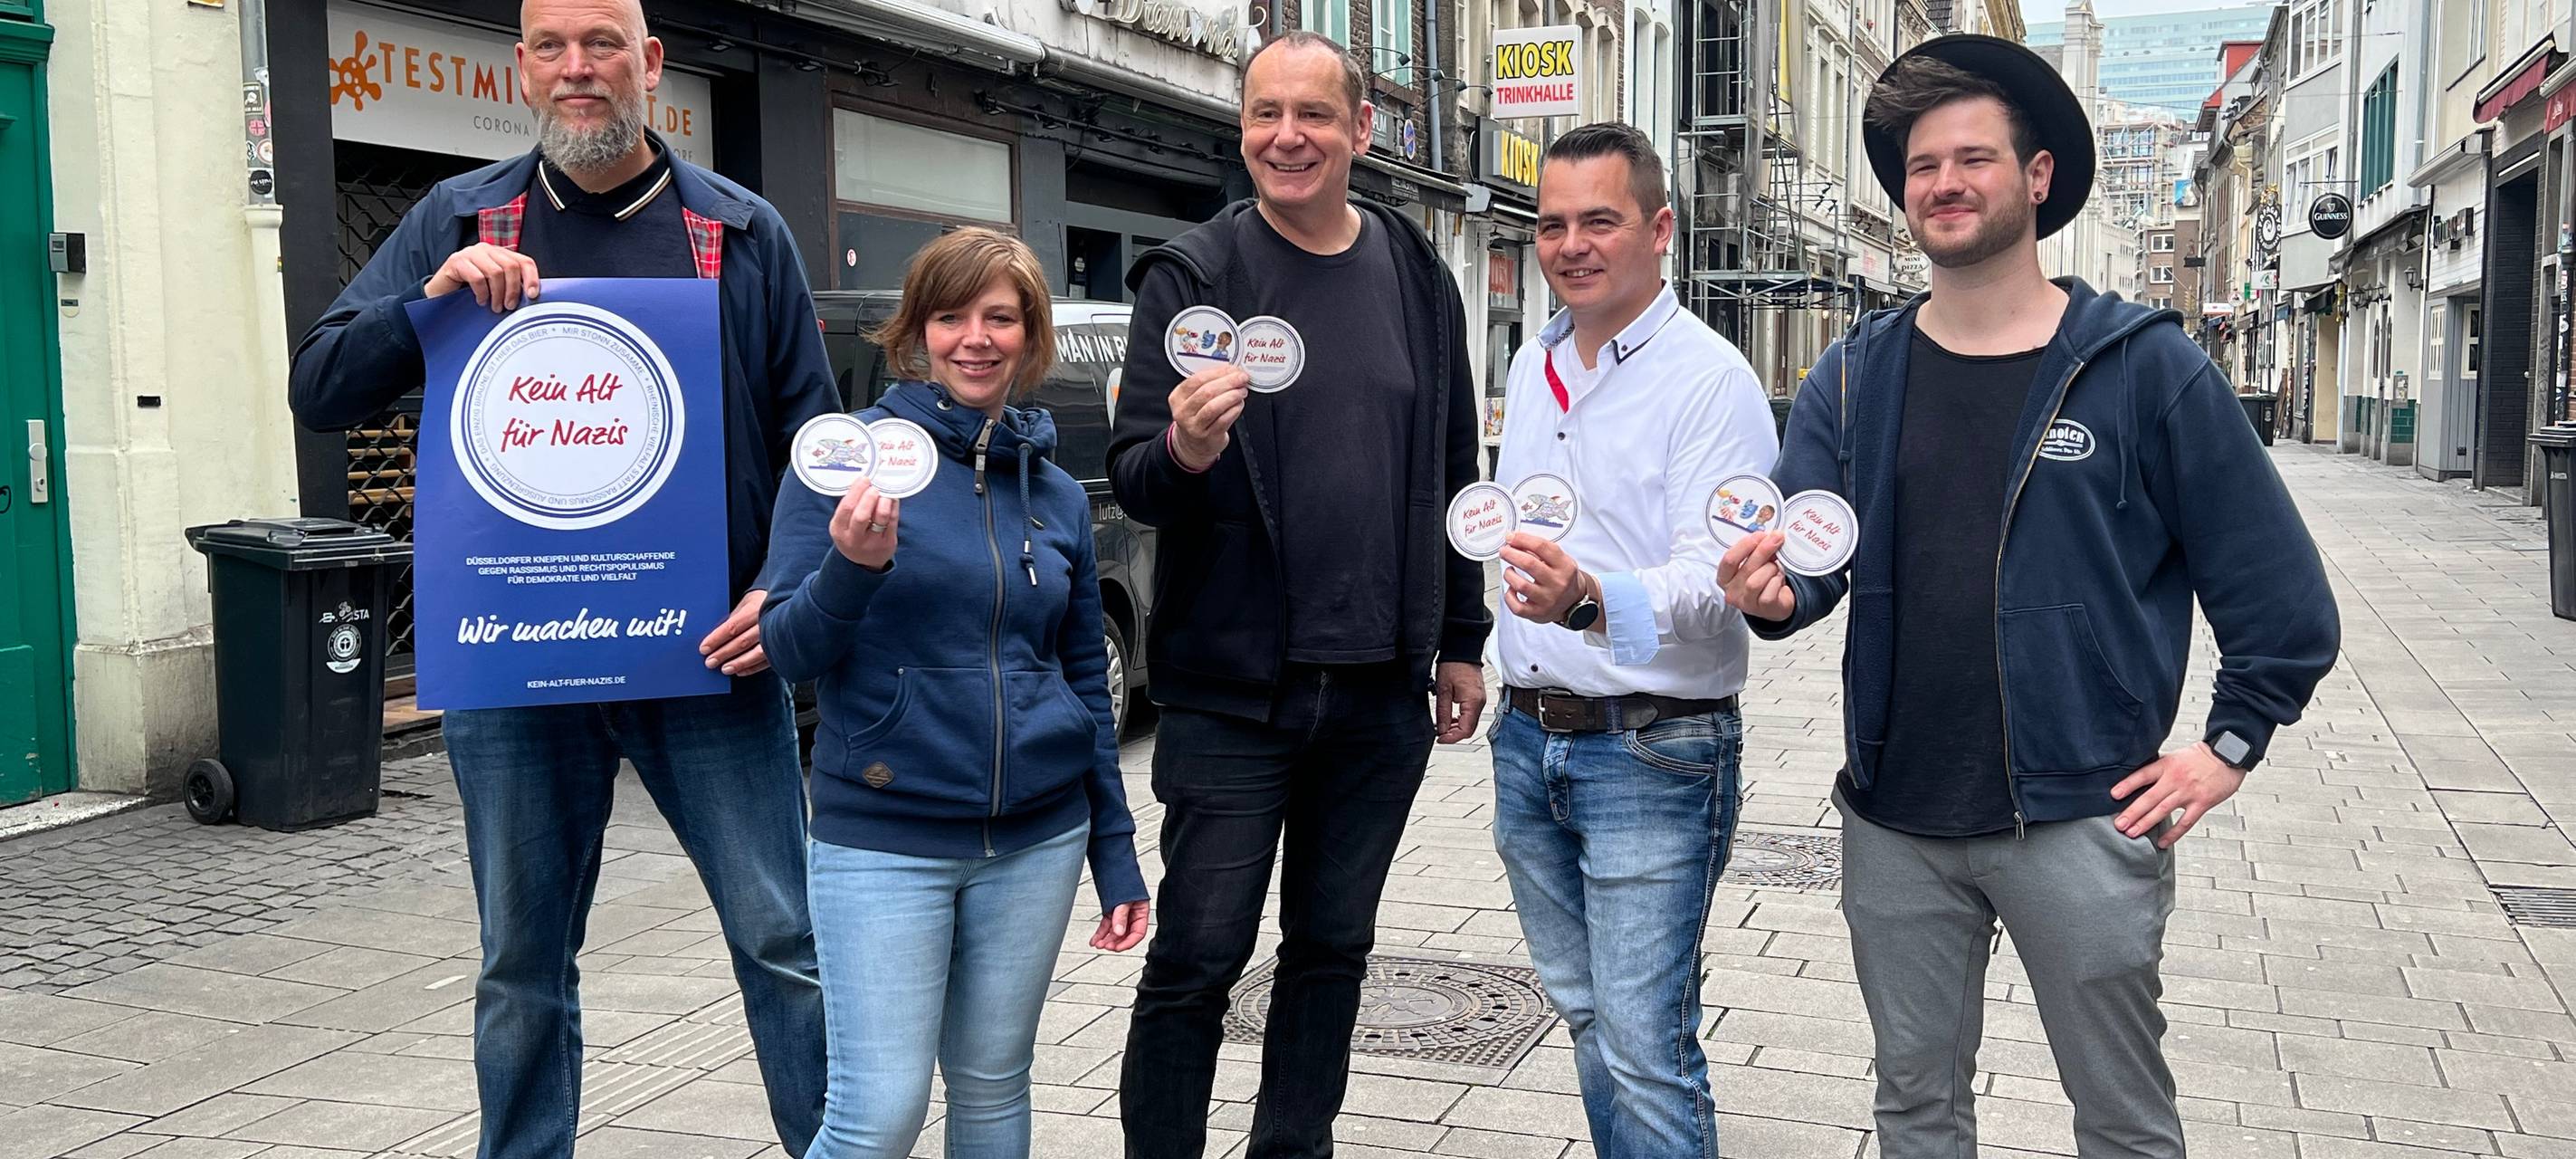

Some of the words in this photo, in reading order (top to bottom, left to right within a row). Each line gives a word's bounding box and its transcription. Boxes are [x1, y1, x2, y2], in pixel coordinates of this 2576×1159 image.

[1496, 41, 1575, 80] KIOSK
[377, 42, 530, 107] TESTMI
[1496, 83, 1573, 105] TRINKHALLE
[473, 115, 530, 137] CORONA
[1501, 129, 1539, 188] KIOSK
[2314, 211, 2348, 221] GUINNESS
[1902, 263, 1923, 272] PIZZA
[495, 345, 513, 363] HIER
[510, 333, 529, 348] DAS
[529, 328, 549, 340] BIER
[562, 327, 580, 335] MIR
[580, 329, 611, 345] STONN
[609, 341, 645, 375] ZUSAMME
[1092, 335, 1116, 362] IN
[1246, 338, 1266, 349] Kein
[1269, 338, 1285, 350] Alt
[1245, 352, 1258, 364] für
[1260, 353, 1286, 363] Nazis
[508, 374, 567, 404] Kein
[576, 372, 624, 404] Alt
[646, 385, 660, 434] RHEINISCHE
[501, 417, 545, 453] für
[549, 417, 628, 446] Nazis
[878, 440, 894, 451] ein
[639, 436, 657, 470] VIELFALT
[490, 463, 545, 503] AUSGRENZUNG
[618, 470, 640, 491] STATT
[549, 496, 568, 506] UND
[569, 487, 617, 506] RASSISMUS
[1463, 506, 1481, 520] Kein
[1479, 514, 1503, 530] Nazis
[1803, 508, 1823, 525] Kein
[1822, 522, 1841, 535] Alt
[1789, 520, 1806, 534] für
[1805, 529, 1832, 551] Nazis
[466, 556, 531, 566] DÜSSELDORFER
[532, 554, 570, 564] KNEIPEN
[570, 554, 589, 563] UND
[590, 551, 675, 562] KULTURSCHAFFENDE
[478, 566, 508, 576] GEGEN
[509, 565, 558, 575] RASSISMUS
[558, 564, 577, 573] UND
[578, 562, 664, 572] RECHTSPOPULISMUS
[507, 575, 524, 585] FÜR
[525, 574, 580, 584] DEMOKRATIE
[580, 573, 600, 582] UND
[600, 572, 637, 581] VIELFALT
[457, 614, 509, 645] Wir
[511, 608, 619, 643] machen
[626, 608, 687, 637] mit!
[527, 675, 626, 689] KEIN-ALT-FUER-NAZIS.DE
